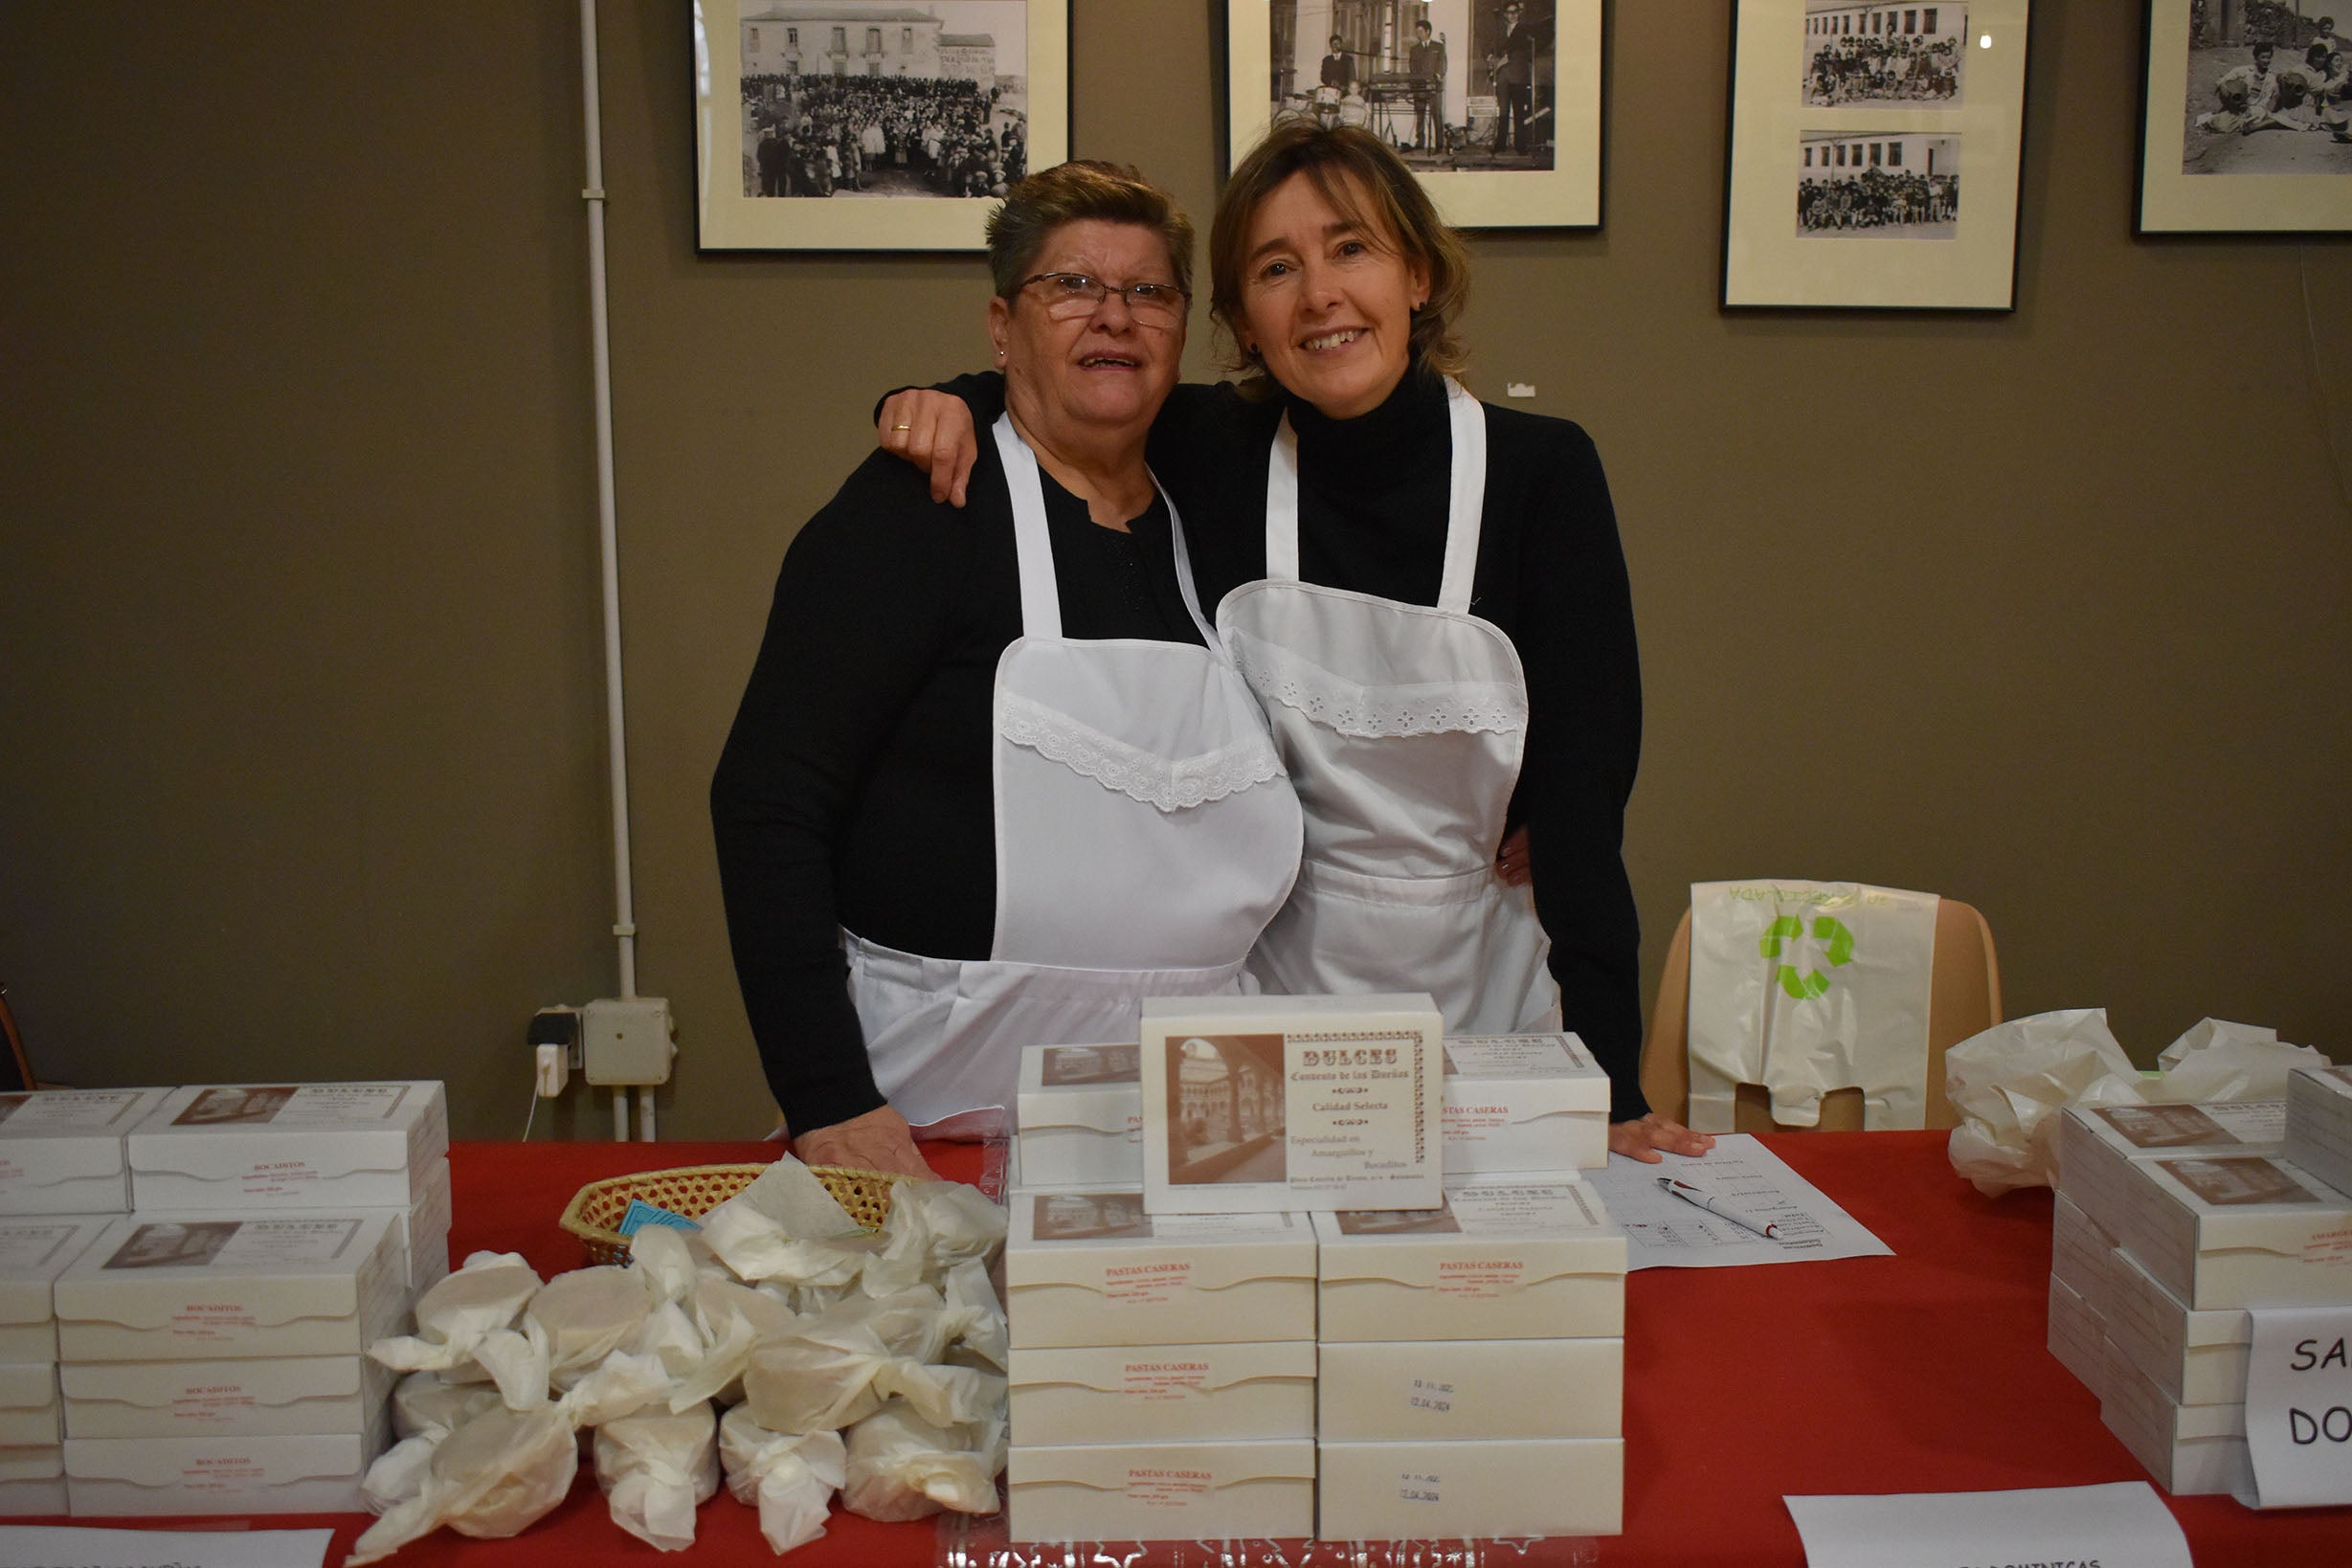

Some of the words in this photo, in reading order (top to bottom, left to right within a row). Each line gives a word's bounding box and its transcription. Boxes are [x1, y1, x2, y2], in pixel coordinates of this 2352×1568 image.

[1303, 1048, 1398, 1066] DULCES
[1311, 1102, 1351, 1111] Calidad
[1355, 1101, 1388, 1110] Selecta
[1467, 1106, 1509, 1114] CASERAS
[1106, 1266, 1143, 1277] PASTAS
[1144, 1263, 1191, 1274] CASERAS
[1439, 1262, 1476, 1270] PASTAS
[1478, 1261, 1524, 1270] CASERAS
[2290, 1336, 2352, 1371] SA
[1125, 1364, 1162, 1373] PASTAS
[1163, 1362, 1209, 1372] CASERAS
[1129, 1469, 1165, 1478] PASTAS
[1166, 1469, 1212, 1480] CASERAS
